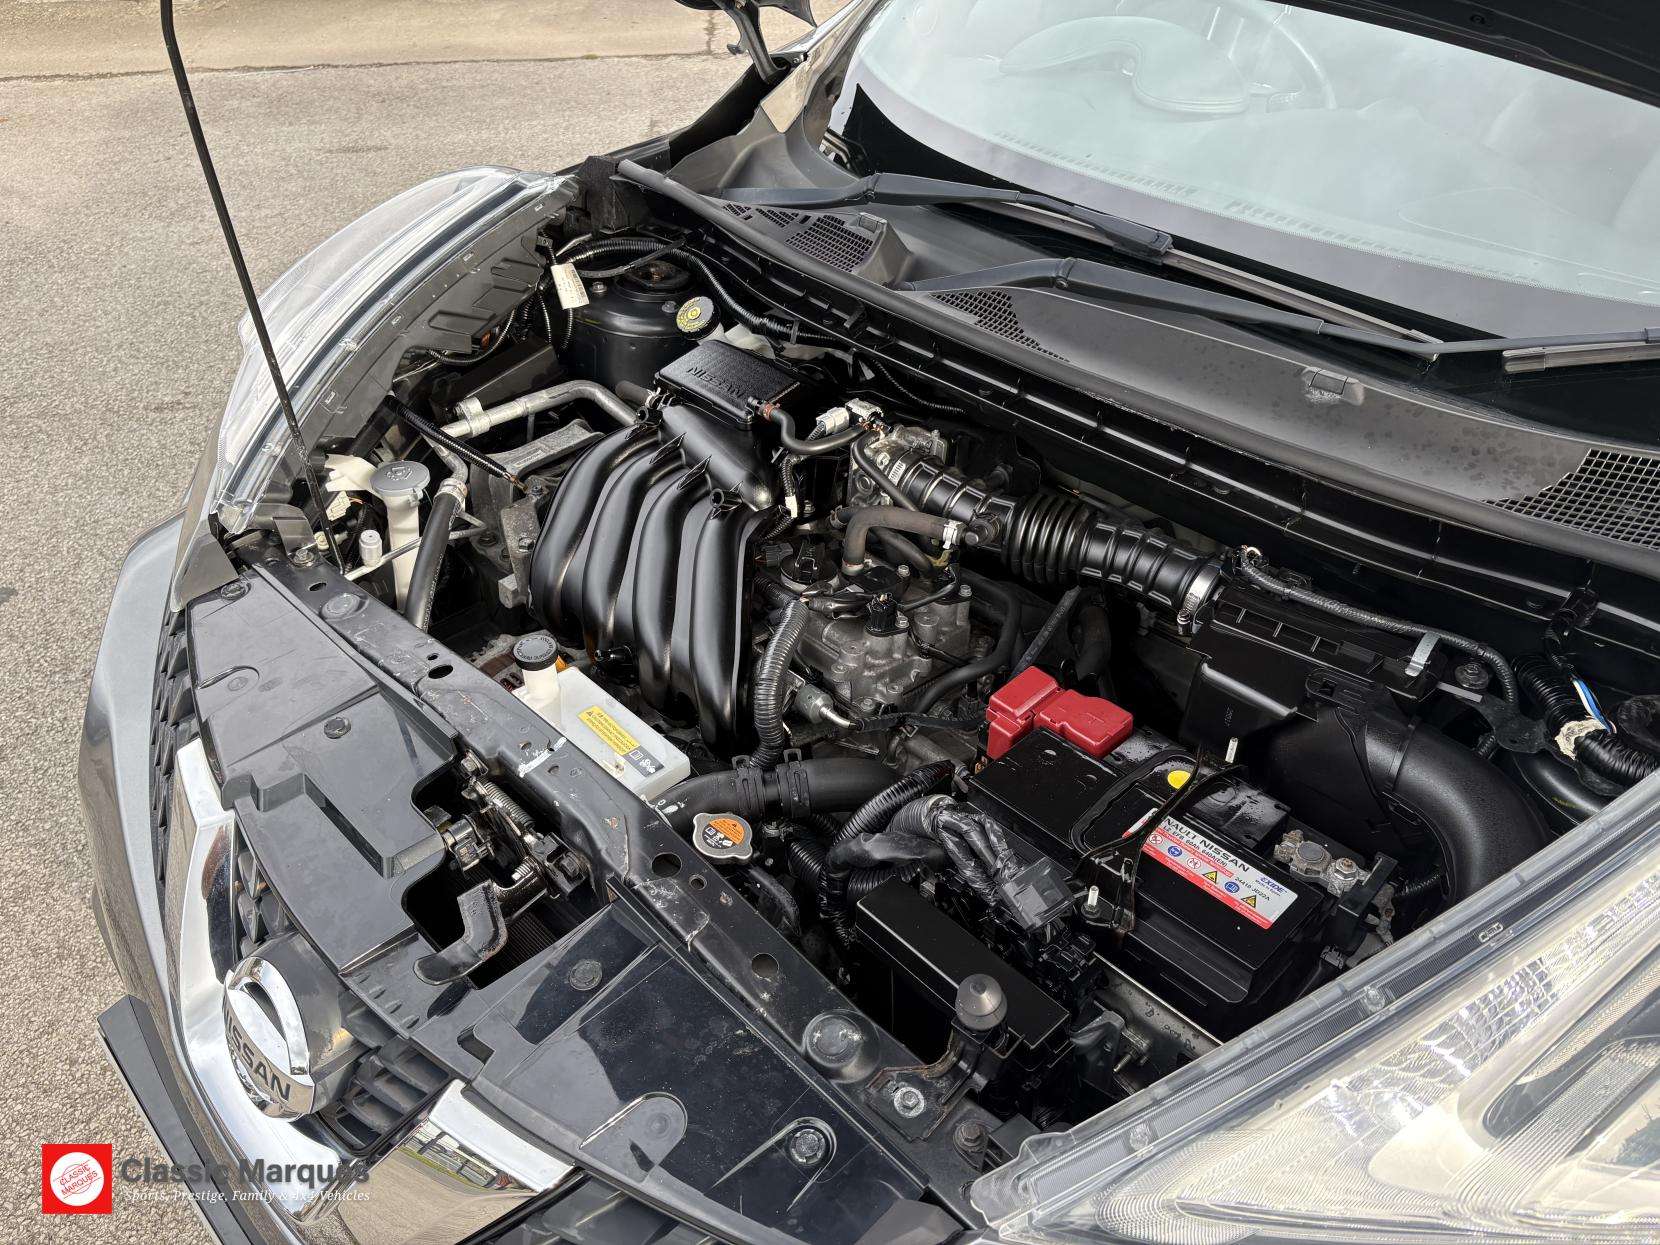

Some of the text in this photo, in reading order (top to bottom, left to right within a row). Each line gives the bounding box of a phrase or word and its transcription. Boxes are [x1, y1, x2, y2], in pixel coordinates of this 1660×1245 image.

[686, 367, 746, 398] NISSAN
[1165, 818, 1197, 840] NAULT
[1199, 839, 1249, 872] NISSAN
